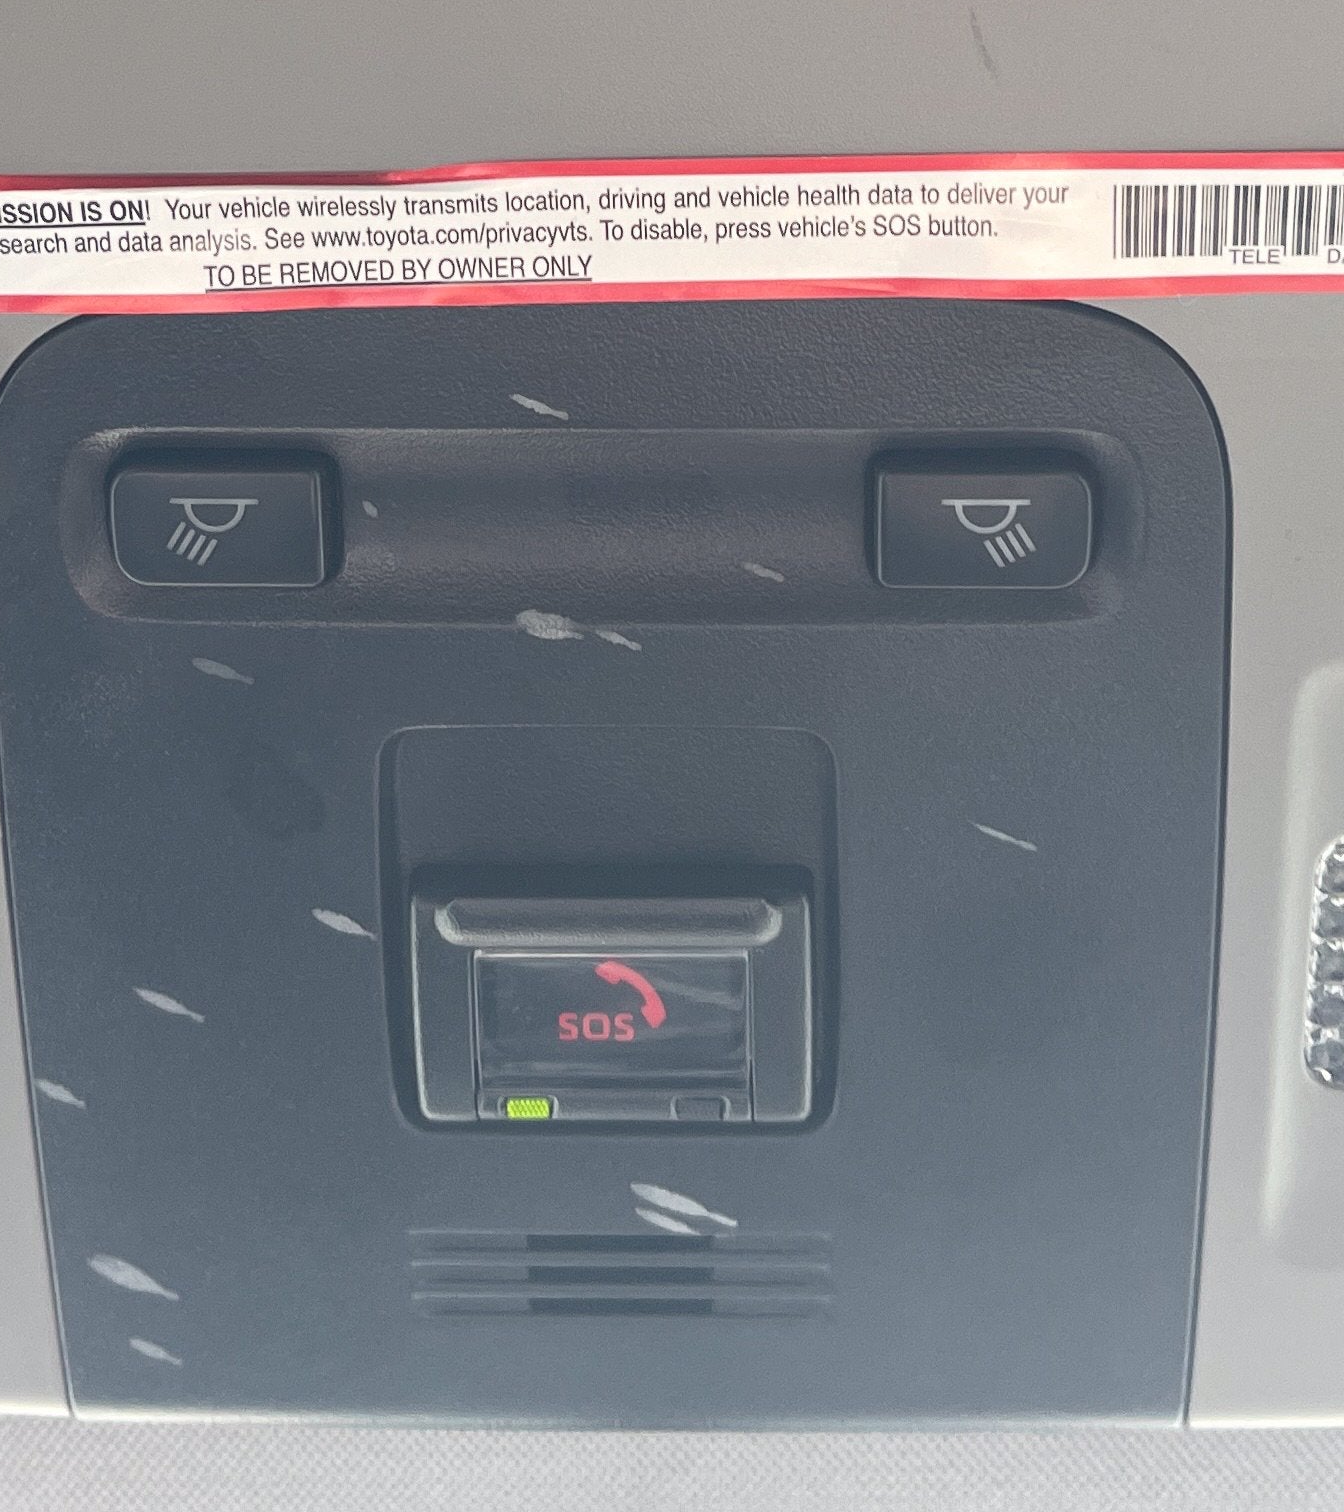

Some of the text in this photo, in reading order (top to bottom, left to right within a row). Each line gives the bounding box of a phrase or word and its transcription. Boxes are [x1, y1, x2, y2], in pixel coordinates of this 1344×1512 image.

[81, 203, 104, 224] IS
[110, 202, 150, 224] ON!
[164, 200, 210, 221] Your
[218, 197, 290, 220] vehicle
[296, 193, 396, 222] wirelessly
[404, 192, 498, 215] transmits
[505, 191, 591, 216] location,
[599, 188, 665, 214] driving
[674, 187, 711, 208] and
[717, 186, 790, 208] vehicle
[797, 185, 860, 206] health
[867, 184, 913, 205] data
[920, 184, 939, 204] to
[947, 183, 1017, 204] deliver
[1023, 186, 1068, 208] your
[74, 232, 111, 253] and
[118, 231, 162, 252] data
[169, 228, 257, 256] analysis.
[264, 227, 305, 249] See
[311, 219, 593, 249] www.toyota.com/privacyvts.
[600, 221, 625, 241] To
[631, 218, 708, 243] disable,
[715, 222, 770, 243] press
[873, 216, 921, 237] SOS
[928, 215, 998, 236] button.
[203, 256, 592, 286] TO BE REMOVED BY OWNER ONLY
[1230, 248, 1281, 265] TELE
[559, 1013, 635, 1042] SOS
